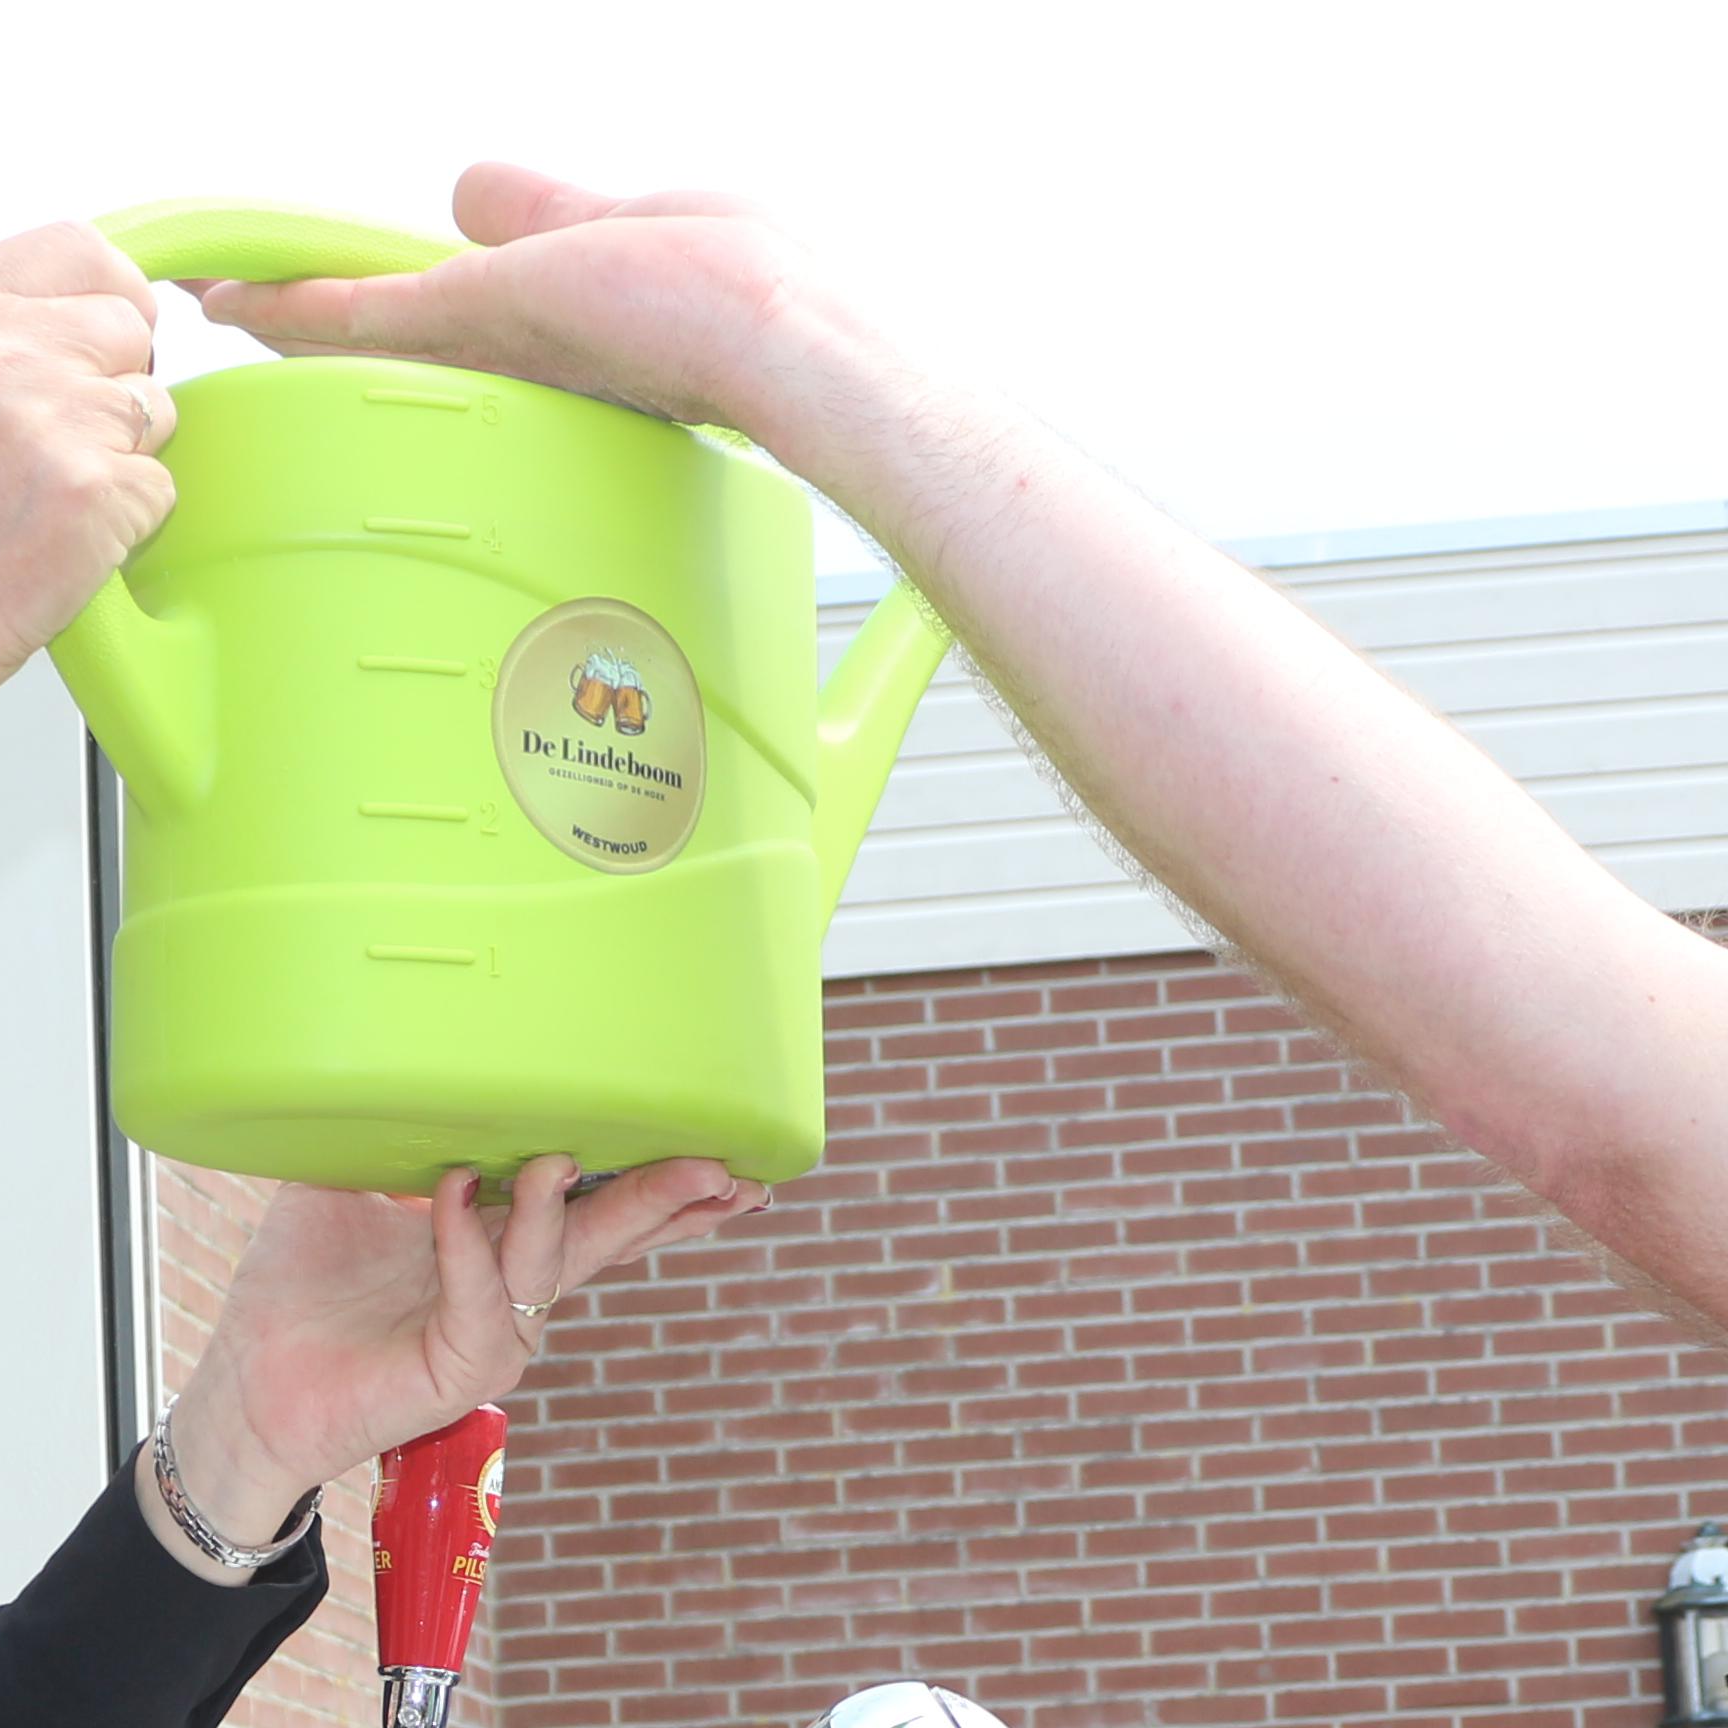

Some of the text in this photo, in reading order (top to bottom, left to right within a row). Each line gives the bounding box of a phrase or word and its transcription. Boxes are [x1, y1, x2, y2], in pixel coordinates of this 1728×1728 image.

[481, 395, 501, 425] 5
[481, 519, 503, 553] 4
[478, 656, 498, 690] 3
[521, 728, 684, 790] De Lindeboom
[548, 767, 614, 789] GEZELLIGHEID
[479, 801, 500, 836] 2
[571, 823, 649, 856] WESTWOUD
[486, 946, 501, 978] 1
